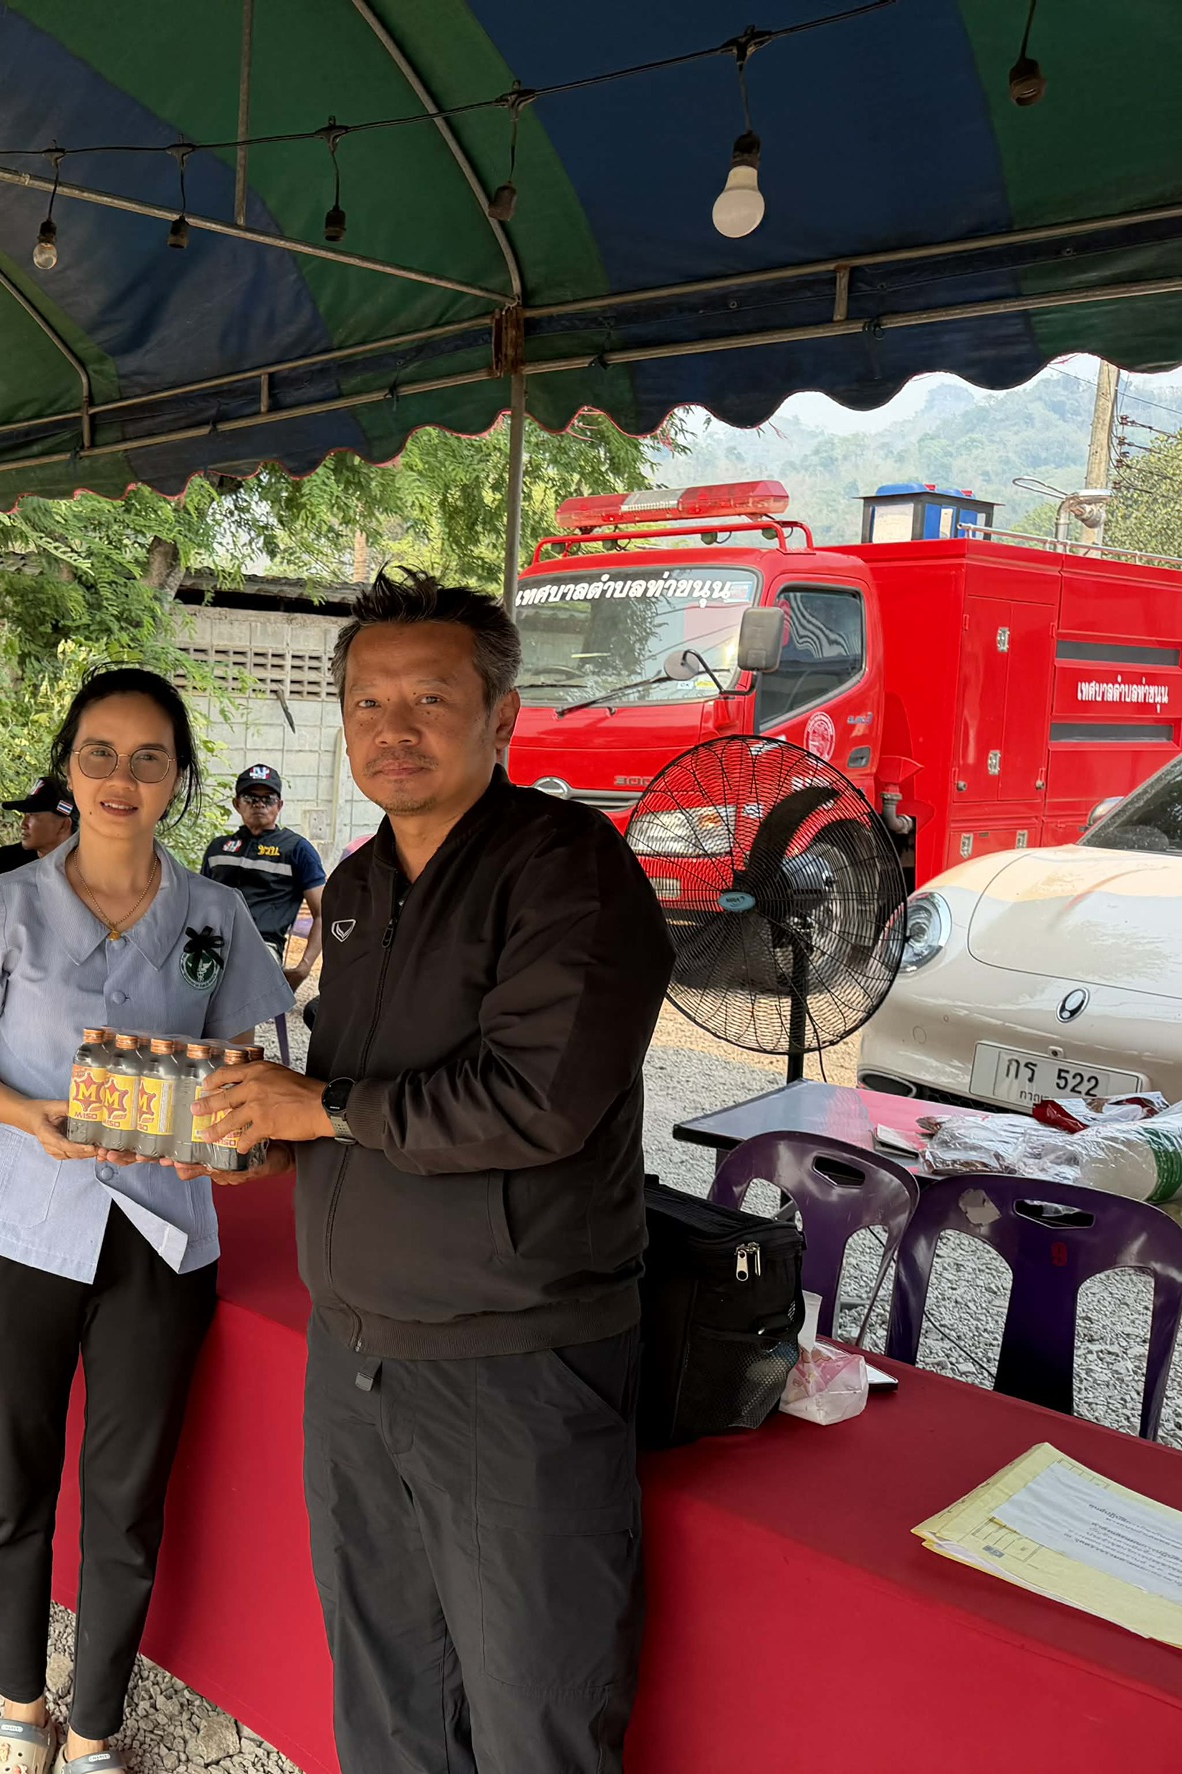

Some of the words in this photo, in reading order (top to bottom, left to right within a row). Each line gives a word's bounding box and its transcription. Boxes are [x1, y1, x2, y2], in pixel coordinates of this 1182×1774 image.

[515, 571, 732, 609] เทศบาลตำบลท่าขนุน
[1077, 674, 1169, 714] เทศบาลตำบลท่าขนุน
[1005, 1058, 1038, 1083] กร
[1055, 1067, 1100, 1098] 522
